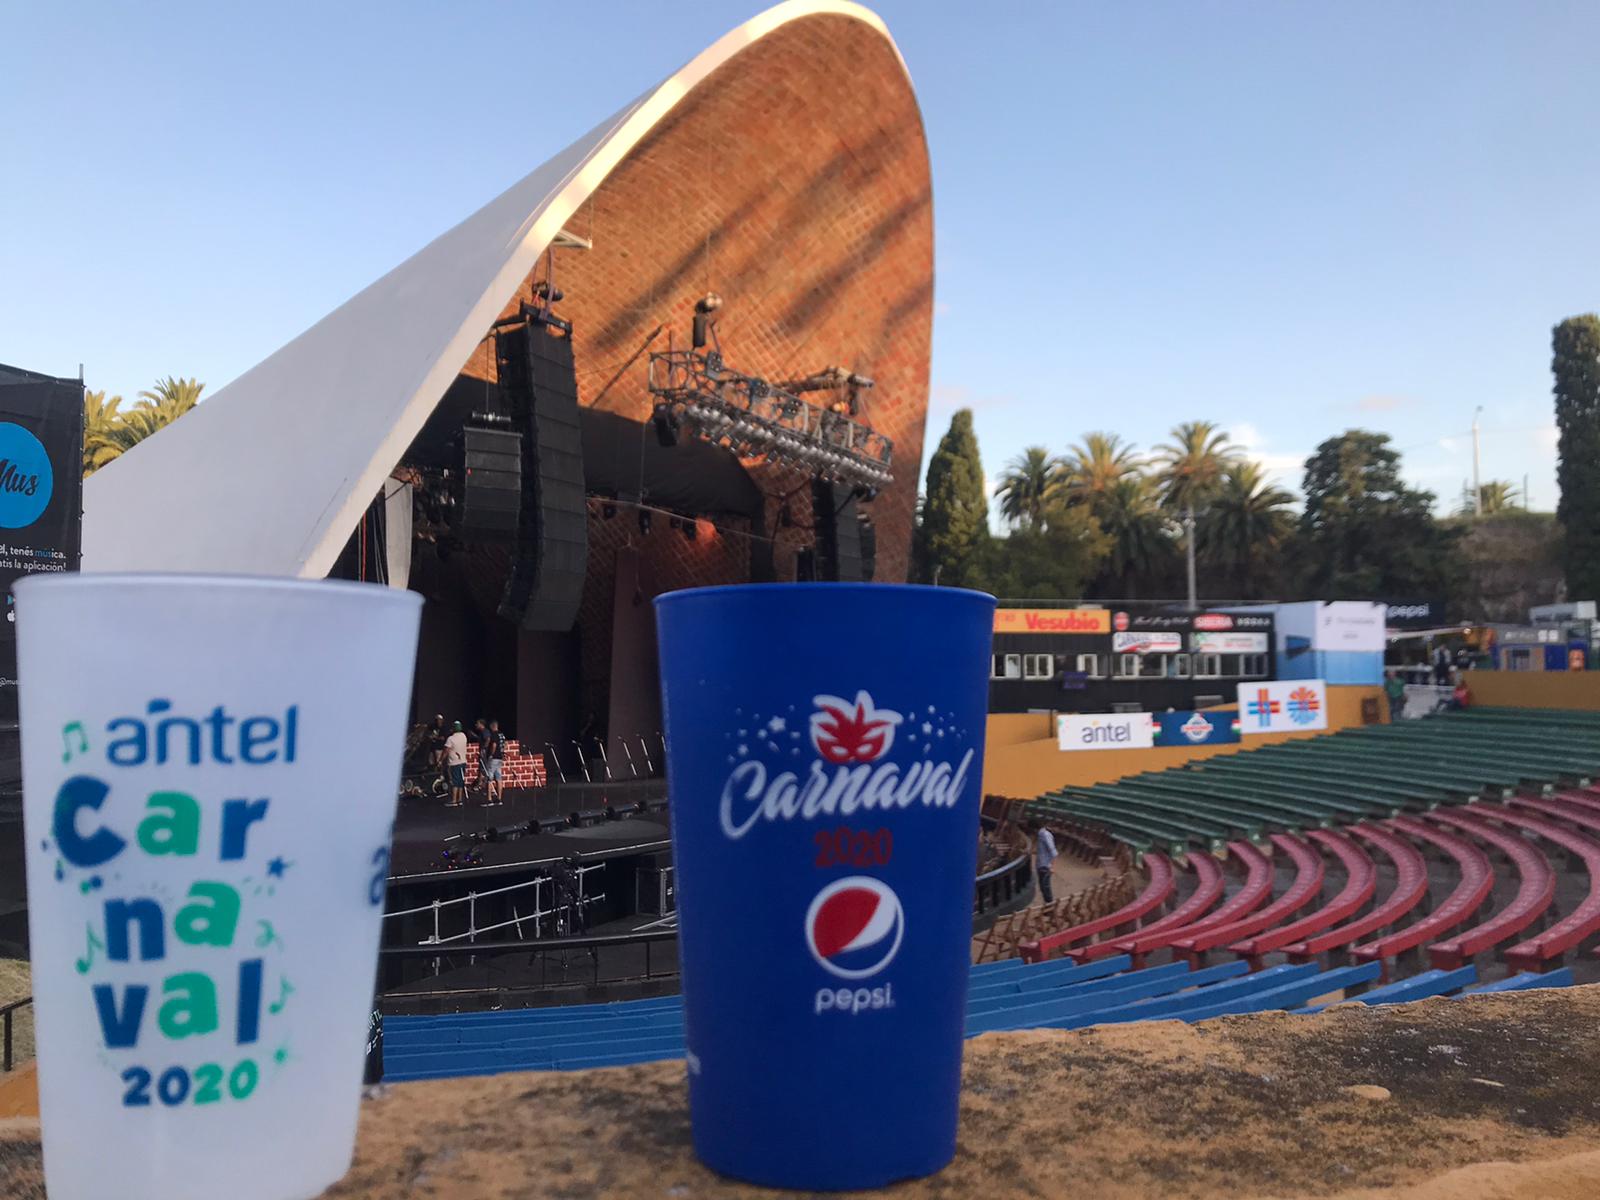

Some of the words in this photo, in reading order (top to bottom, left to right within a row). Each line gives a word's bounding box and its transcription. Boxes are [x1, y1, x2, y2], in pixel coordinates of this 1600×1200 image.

[10, 546, 34, 556] tenés
[14, 559, 22, 568] la
[23, 561, 67, 573] aplicación!
[1025, 612, 1100, 630] Vesubio
[1387, 604, 1430, 618] pepsi
[106, 699, 299, 767] antel
[1082, 720, 1131, 743] antel
[719, 747, 974, 840] Carnaval
[814, 826, 893, 868] 2020
[815, 983, 891, 1015] pepsi
[122, 1060, 259, 1107] 2020
